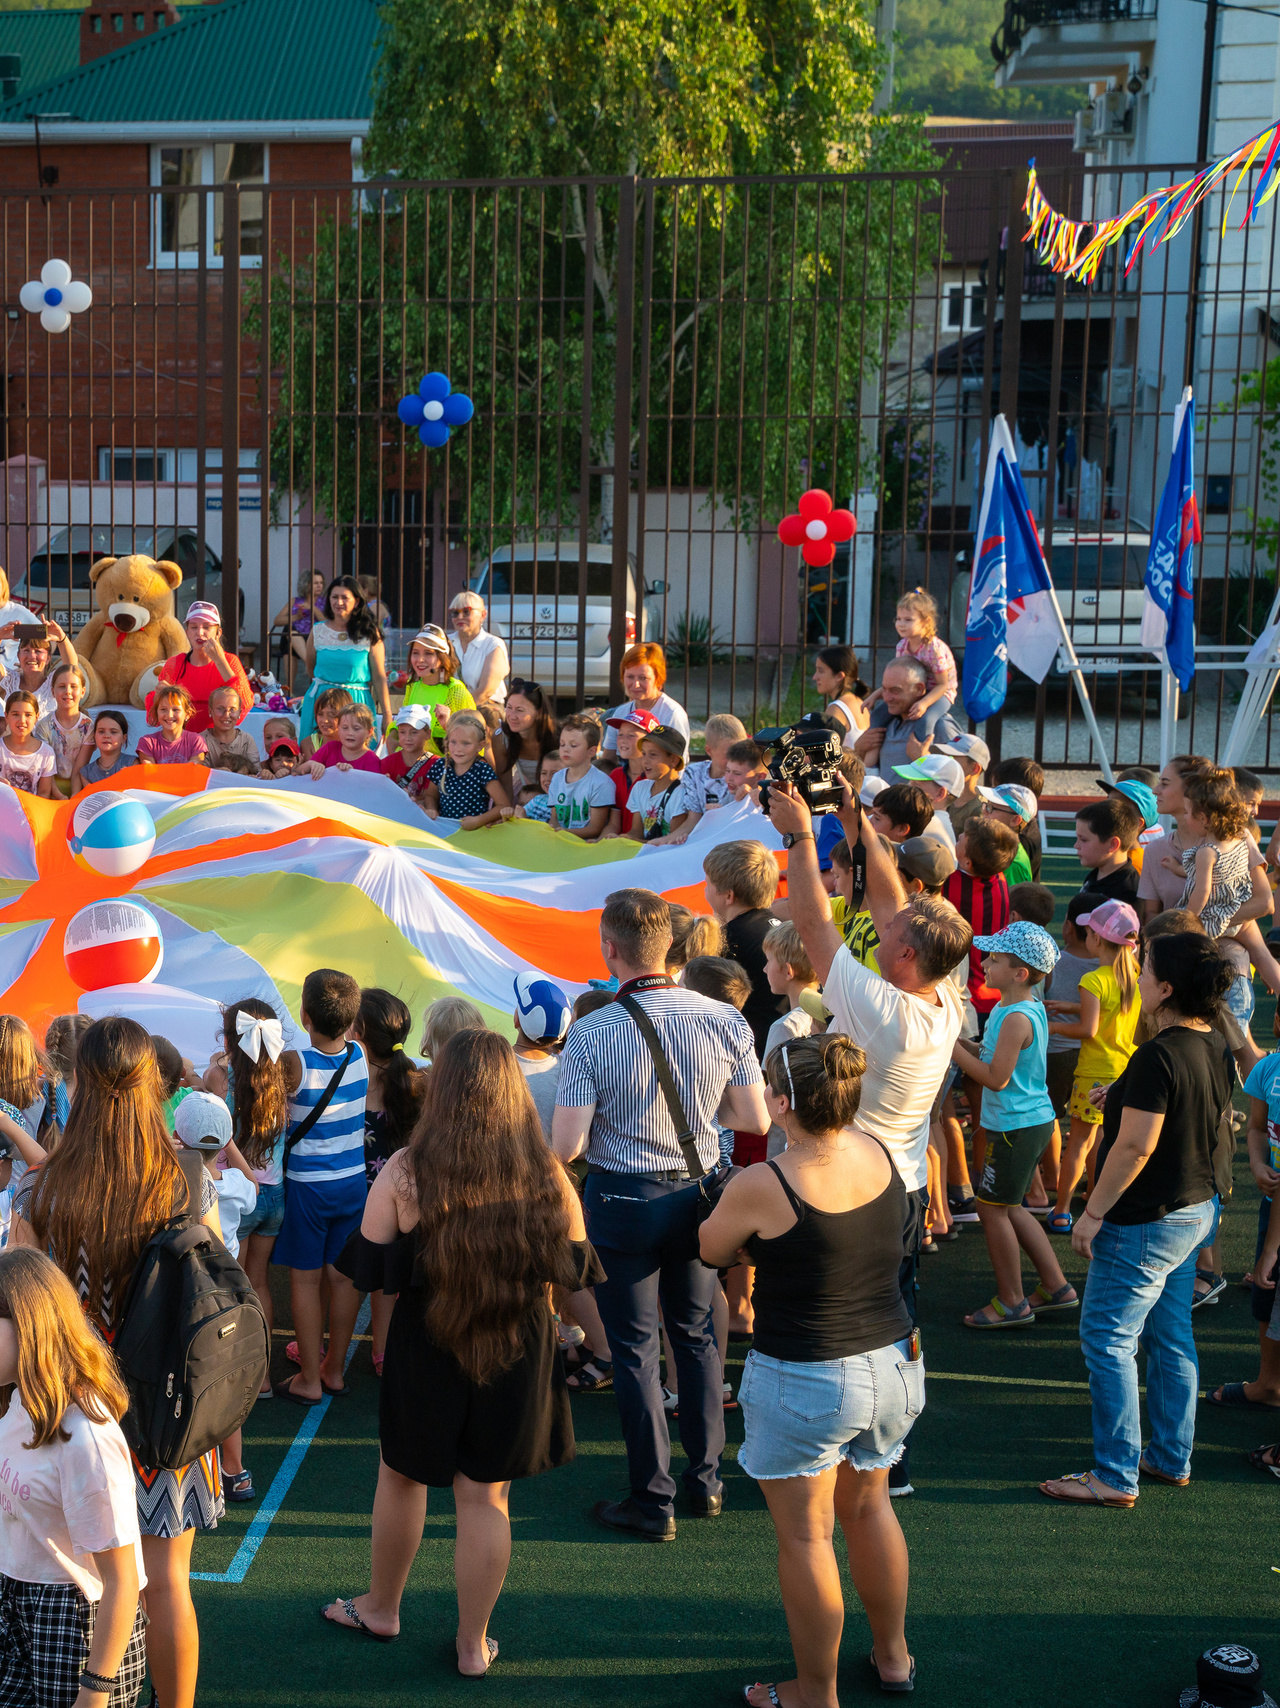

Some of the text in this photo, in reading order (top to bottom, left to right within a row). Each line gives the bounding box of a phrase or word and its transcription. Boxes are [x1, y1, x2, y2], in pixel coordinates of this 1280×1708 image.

[637, 978, 666, 987] Canon
[0, 1458, 11, 1484] to
[11, 1471, 30, 1501] be
